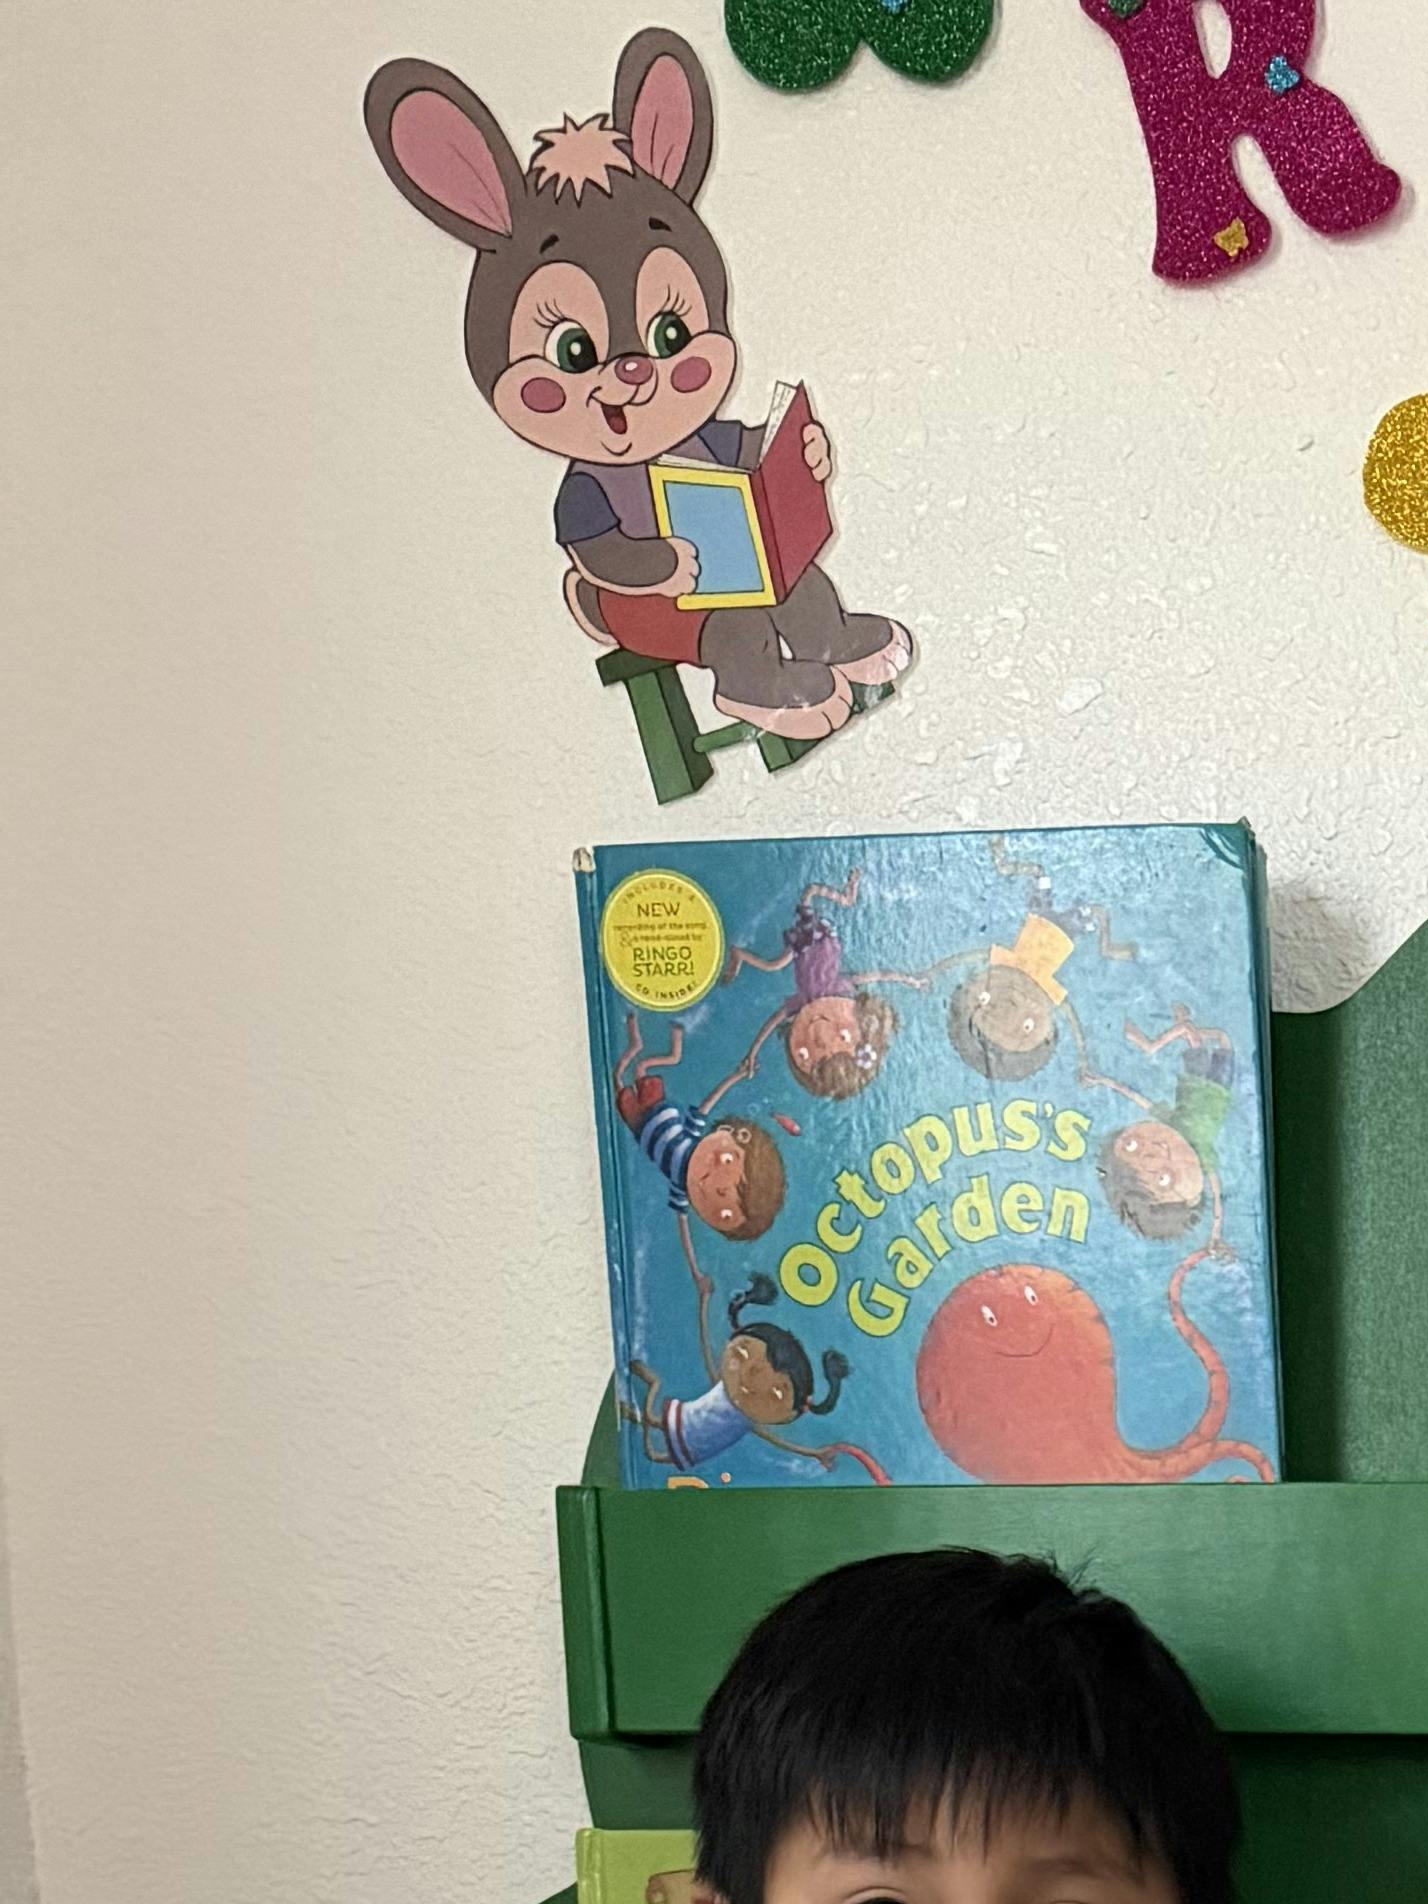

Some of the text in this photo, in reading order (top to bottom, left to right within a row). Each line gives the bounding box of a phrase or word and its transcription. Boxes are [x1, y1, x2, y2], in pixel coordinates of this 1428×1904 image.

[637, 902, 680, 917] NEW
[633, 946, 692, 961] RINGO
[632, 961, 694, 977] STARR!
[779, 1098, 1093, 1308] Octopus's
[846, 1175, 1093, 1338] Garden
